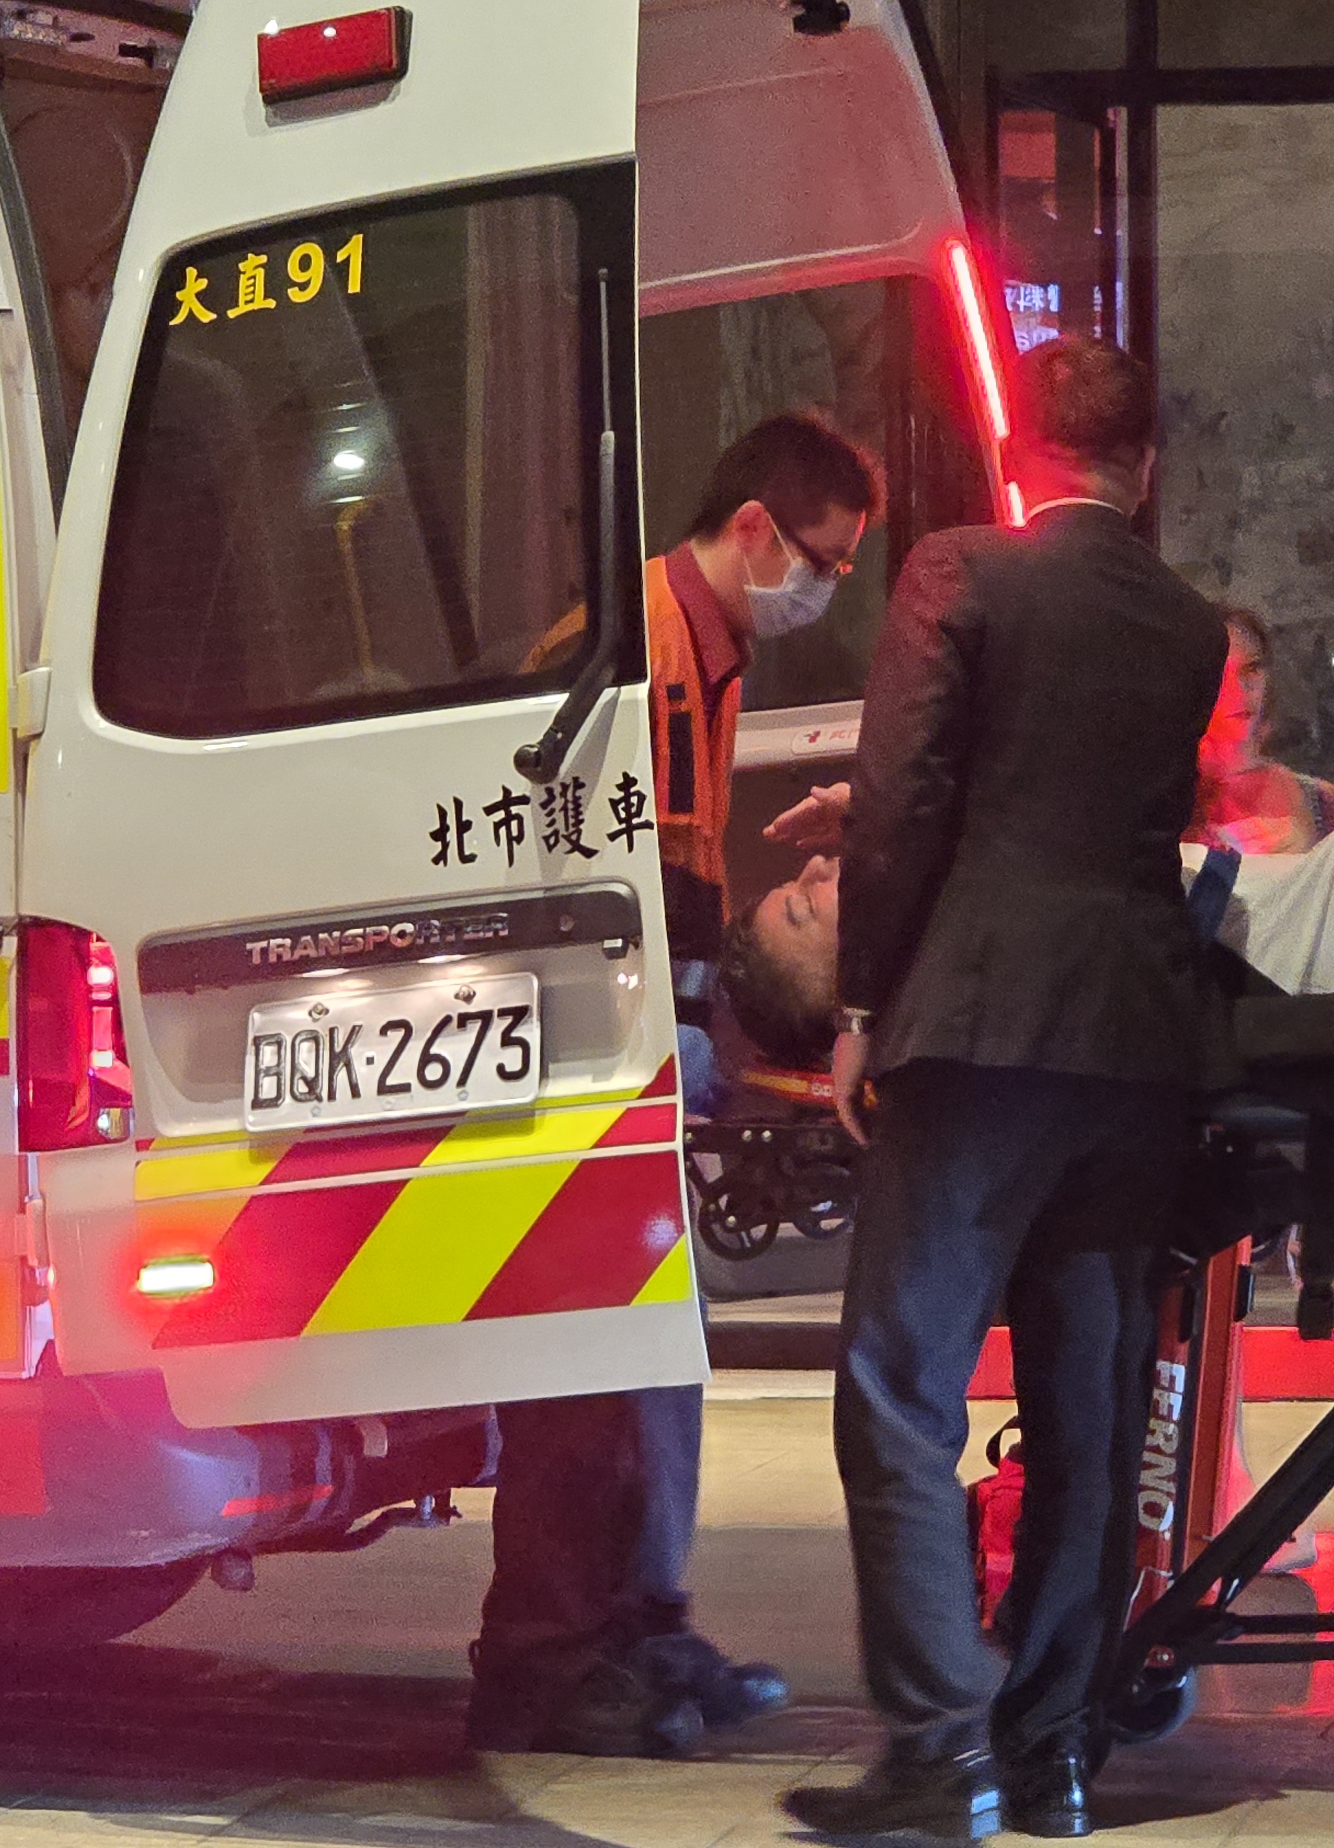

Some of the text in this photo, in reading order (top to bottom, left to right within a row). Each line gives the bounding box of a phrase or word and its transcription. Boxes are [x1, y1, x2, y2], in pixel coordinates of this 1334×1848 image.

[429, 771, 655, 868] 北市護車
[245, 912, 509, 965] TRANSPORTER
[1137, 1359, 1186, 1532] FERNO
